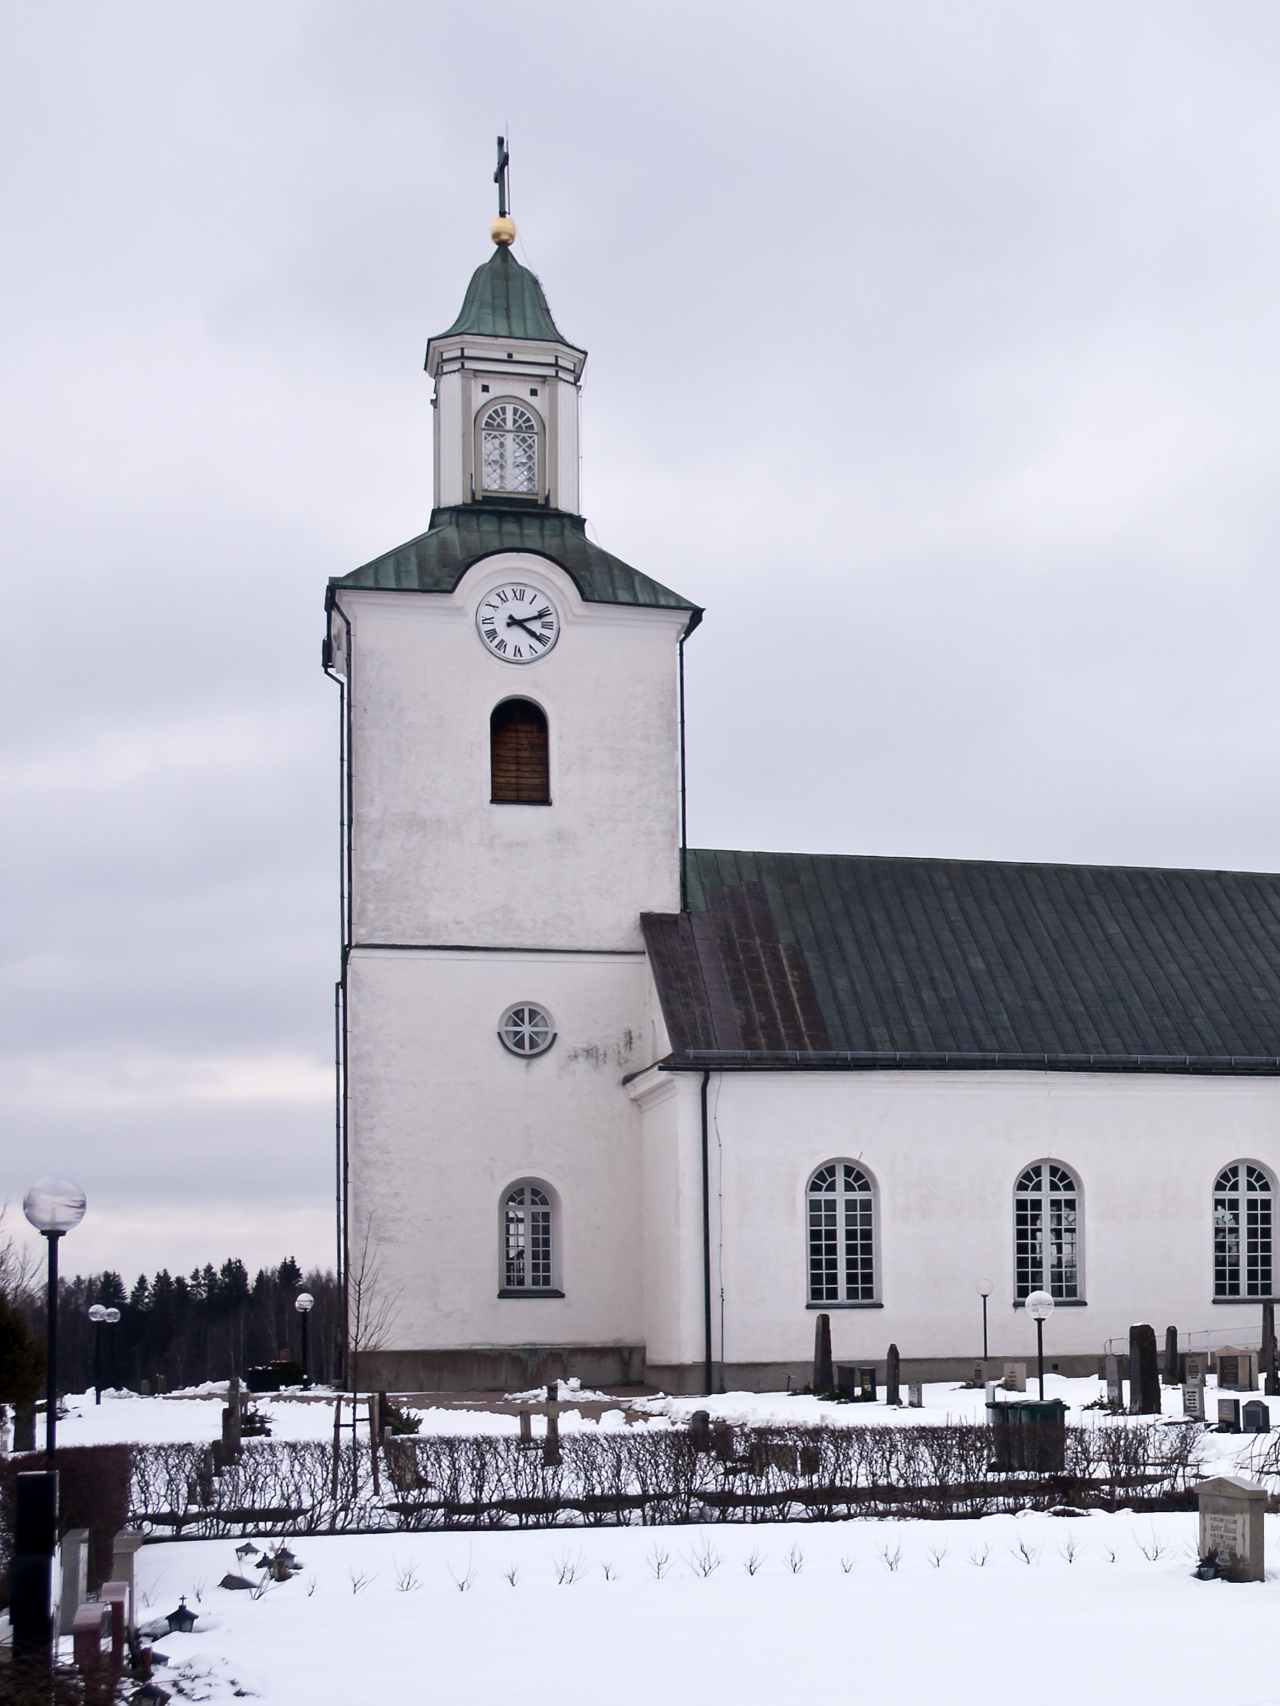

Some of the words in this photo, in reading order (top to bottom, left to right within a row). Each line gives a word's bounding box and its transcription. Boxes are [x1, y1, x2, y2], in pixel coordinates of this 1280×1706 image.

[496, 590, 509, 605] XI
[512, 588, 526, 601] XII
[485, 601, 499, 612] X
[482, 616, 494, 625] IX
[541, 621, 554, 630] III
[484, 628, 498, 643] VIII
[495, 639, 508, 654] VII
[513, 645, 523, 657] VI
[529, 643, 538, 656] V
